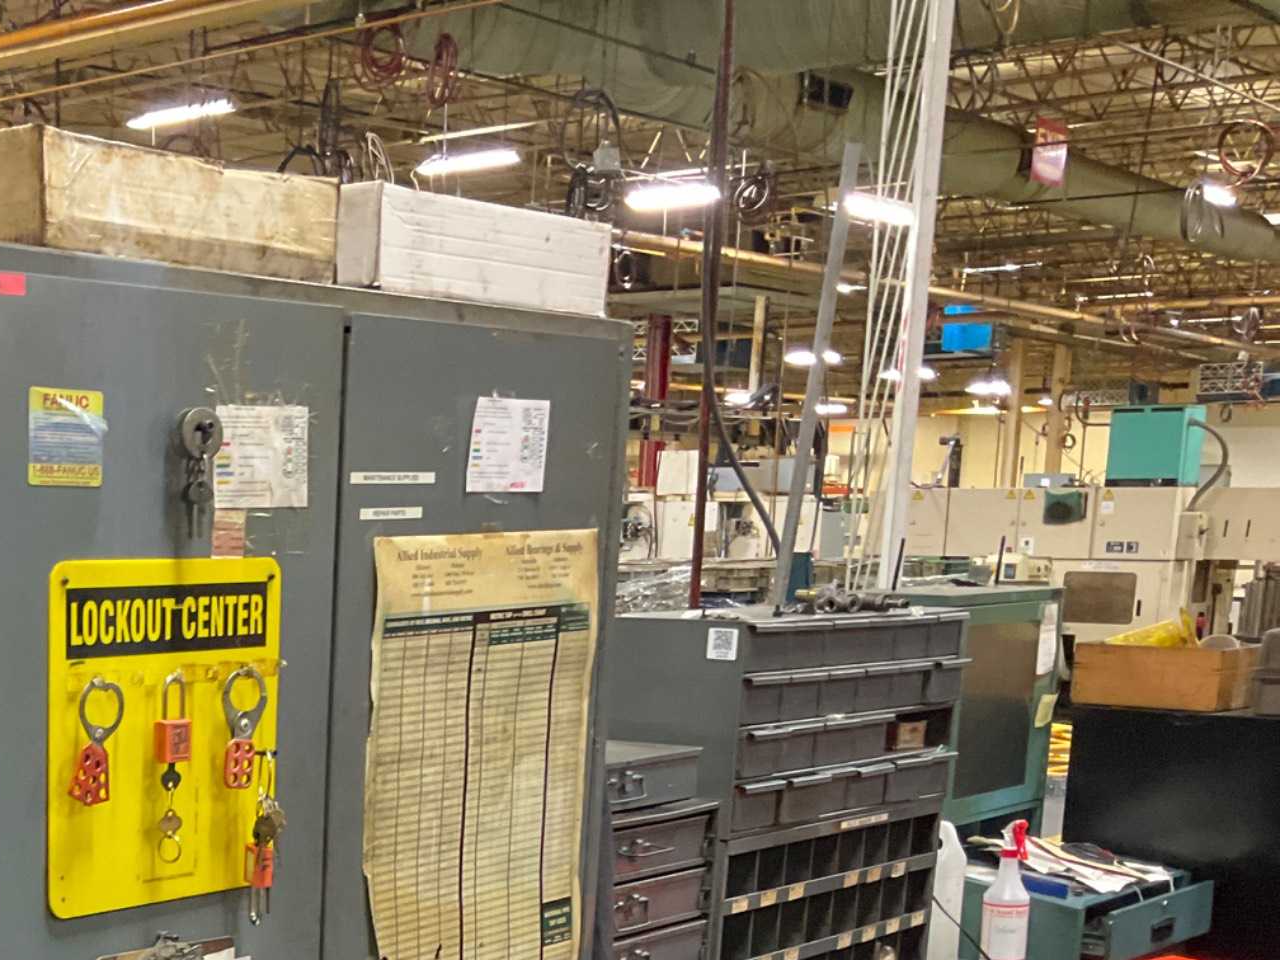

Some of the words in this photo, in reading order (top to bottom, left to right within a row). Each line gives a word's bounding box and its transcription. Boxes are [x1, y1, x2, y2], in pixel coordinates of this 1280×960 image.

[420, 548, 456, 560] Industrial
[70, 597, 175, 647] LOCKOUT
[181, 594, 264, 641] CENTER
